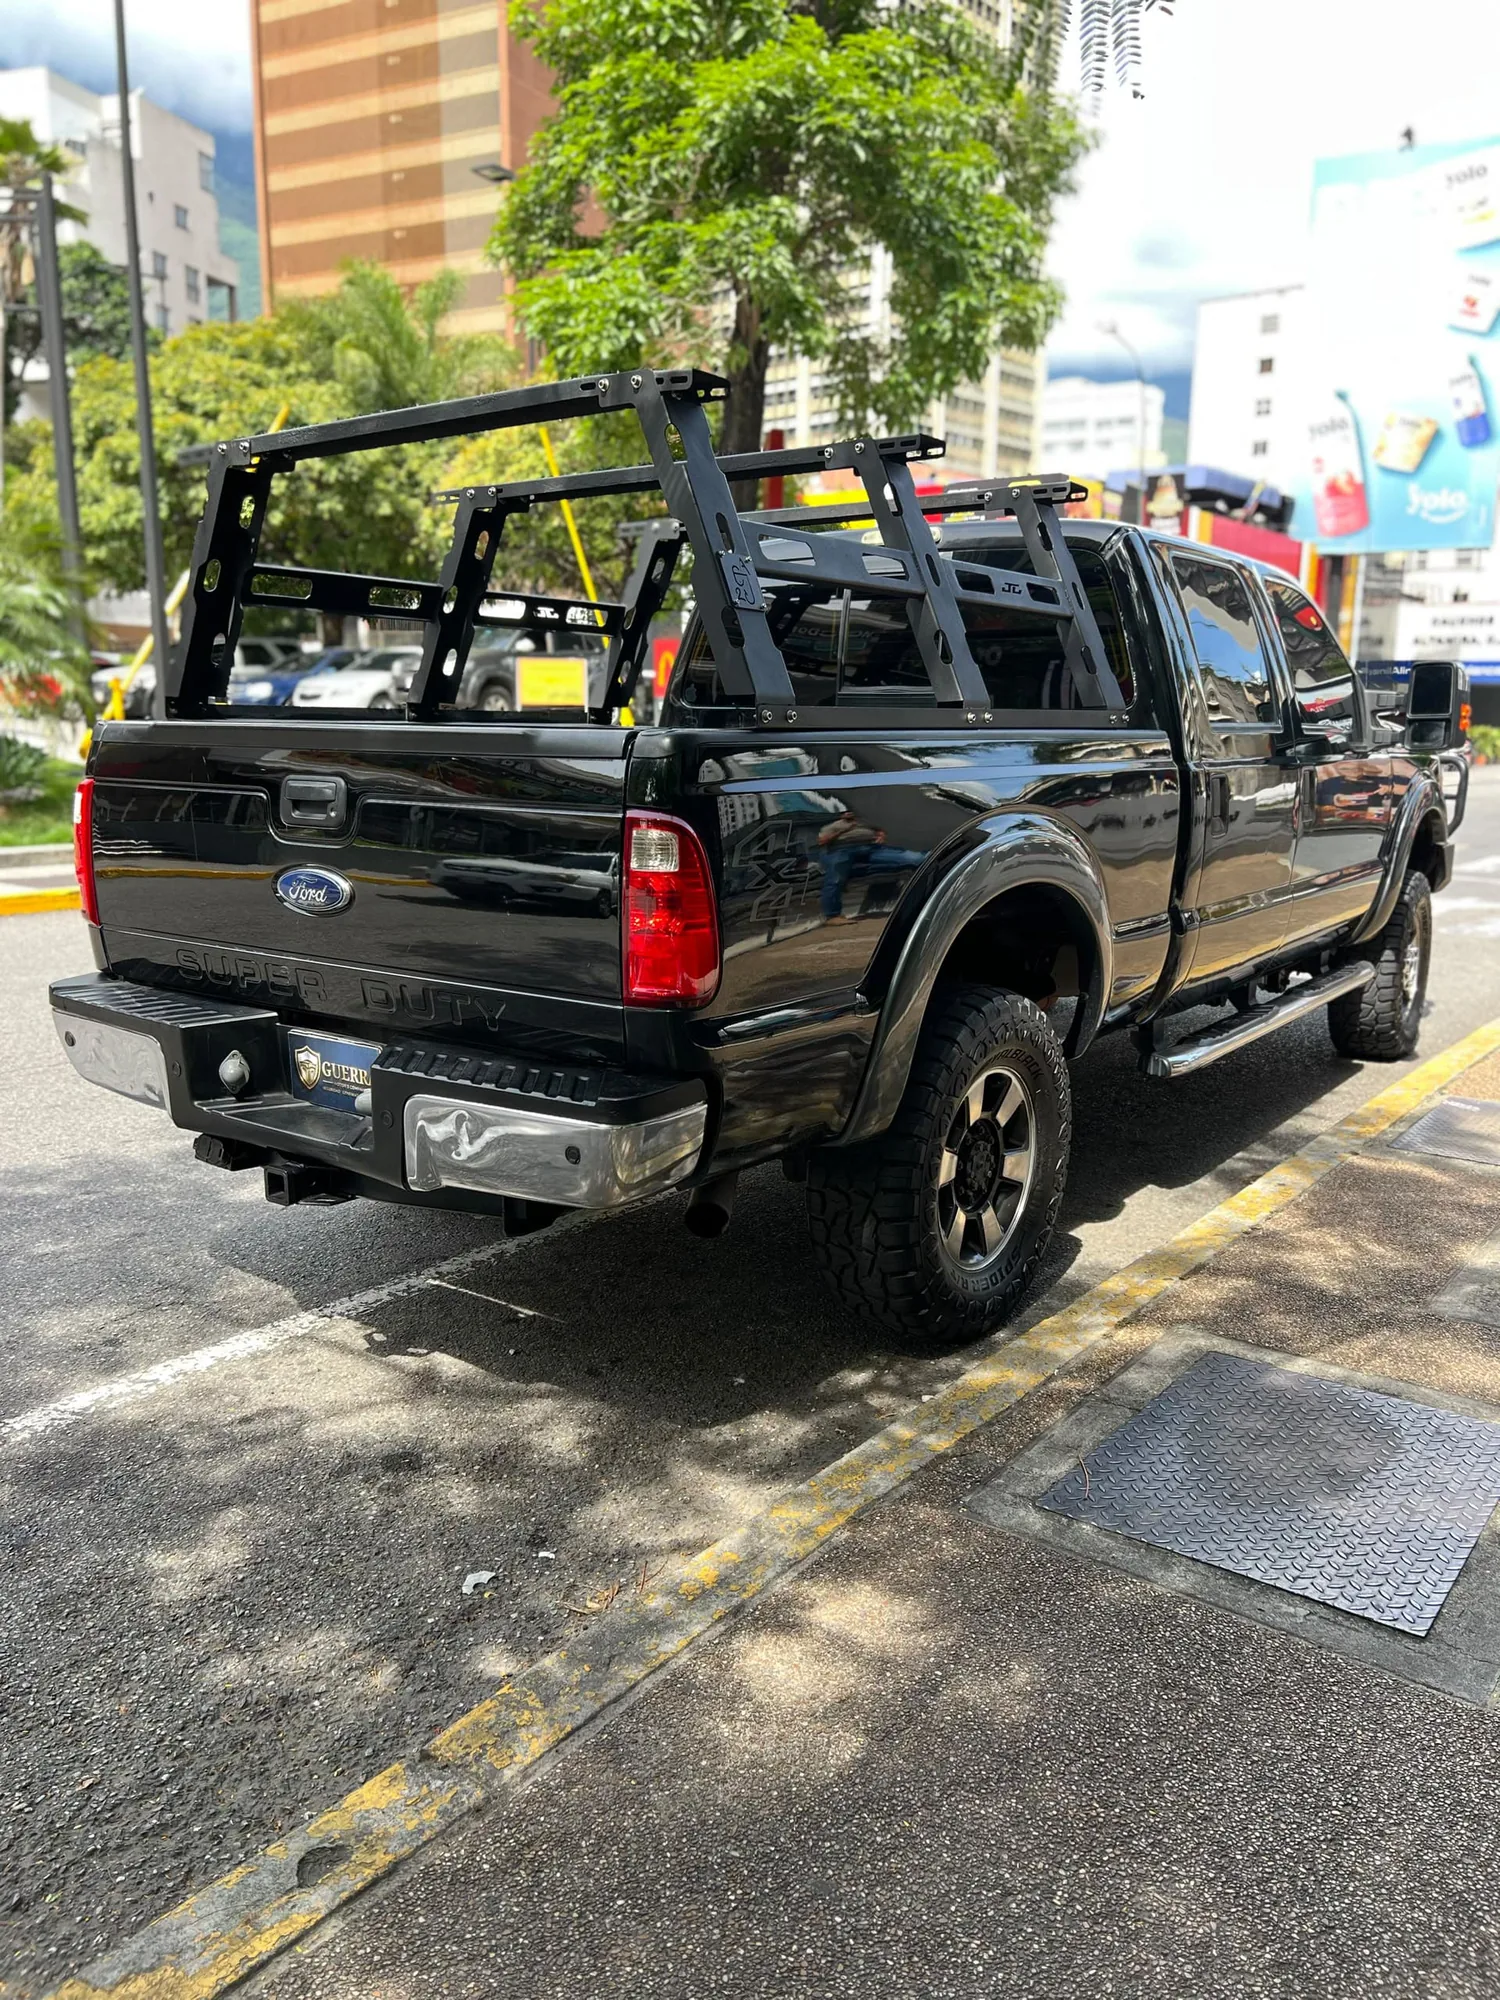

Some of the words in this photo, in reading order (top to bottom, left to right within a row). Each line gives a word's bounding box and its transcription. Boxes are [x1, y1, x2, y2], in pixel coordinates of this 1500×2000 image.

[289, 875, 328, 903] Ford
[176, 948, 328, 1003] SUPER
[360, 977, 506, 1031] DUTY
[971, 1245, 1021, 1292] SPIDER
